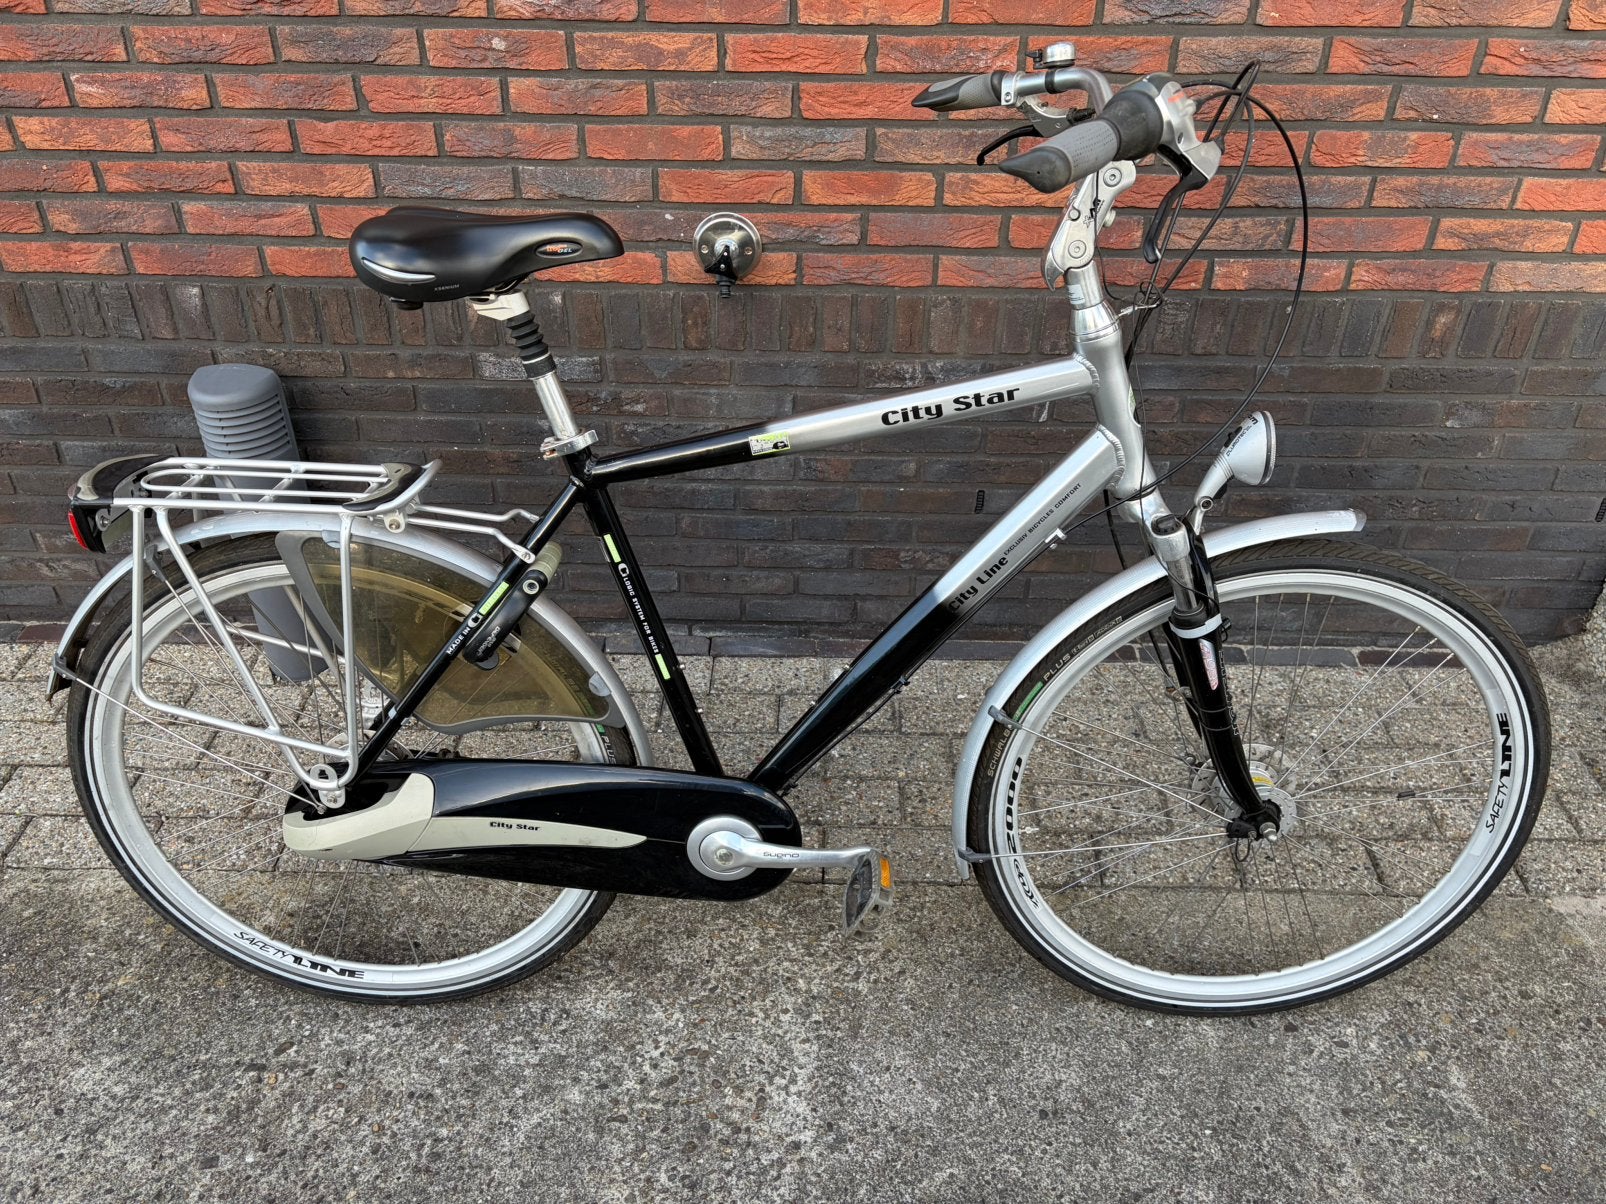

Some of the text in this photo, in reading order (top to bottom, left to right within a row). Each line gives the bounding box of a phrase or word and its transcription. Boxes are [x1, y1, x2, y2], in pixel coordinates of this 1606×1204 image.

[881, 387, 1020, 426] City Star
[1027, 508, 1055, 534] BICYCLES
[1054, 483, 1082, 509] COMFORT
[948, 556, 1009, 611] City Line
[623, 577, 635, 596] LOGIC
[632, 597, 646, 621] SYSTEM
[642, 622, 652, 636] FOR
[648, 636, 660, 654] BIKES
[446, 635, 465, 656] MADE
[462, 626, 472, 636] IN
[1043, 652, 1072, 682] PLUS
[600, 734, 617, 765] PLUS
[986, 725, 1013, 777] SCHWALB
[1485, 712, 1513, 834] SAFETY LINE
[490, 821, 541, 831] City Star
[1005, 756, 1023, 854] 2000
[233, 931, 365, 979] SAFETY LINE
